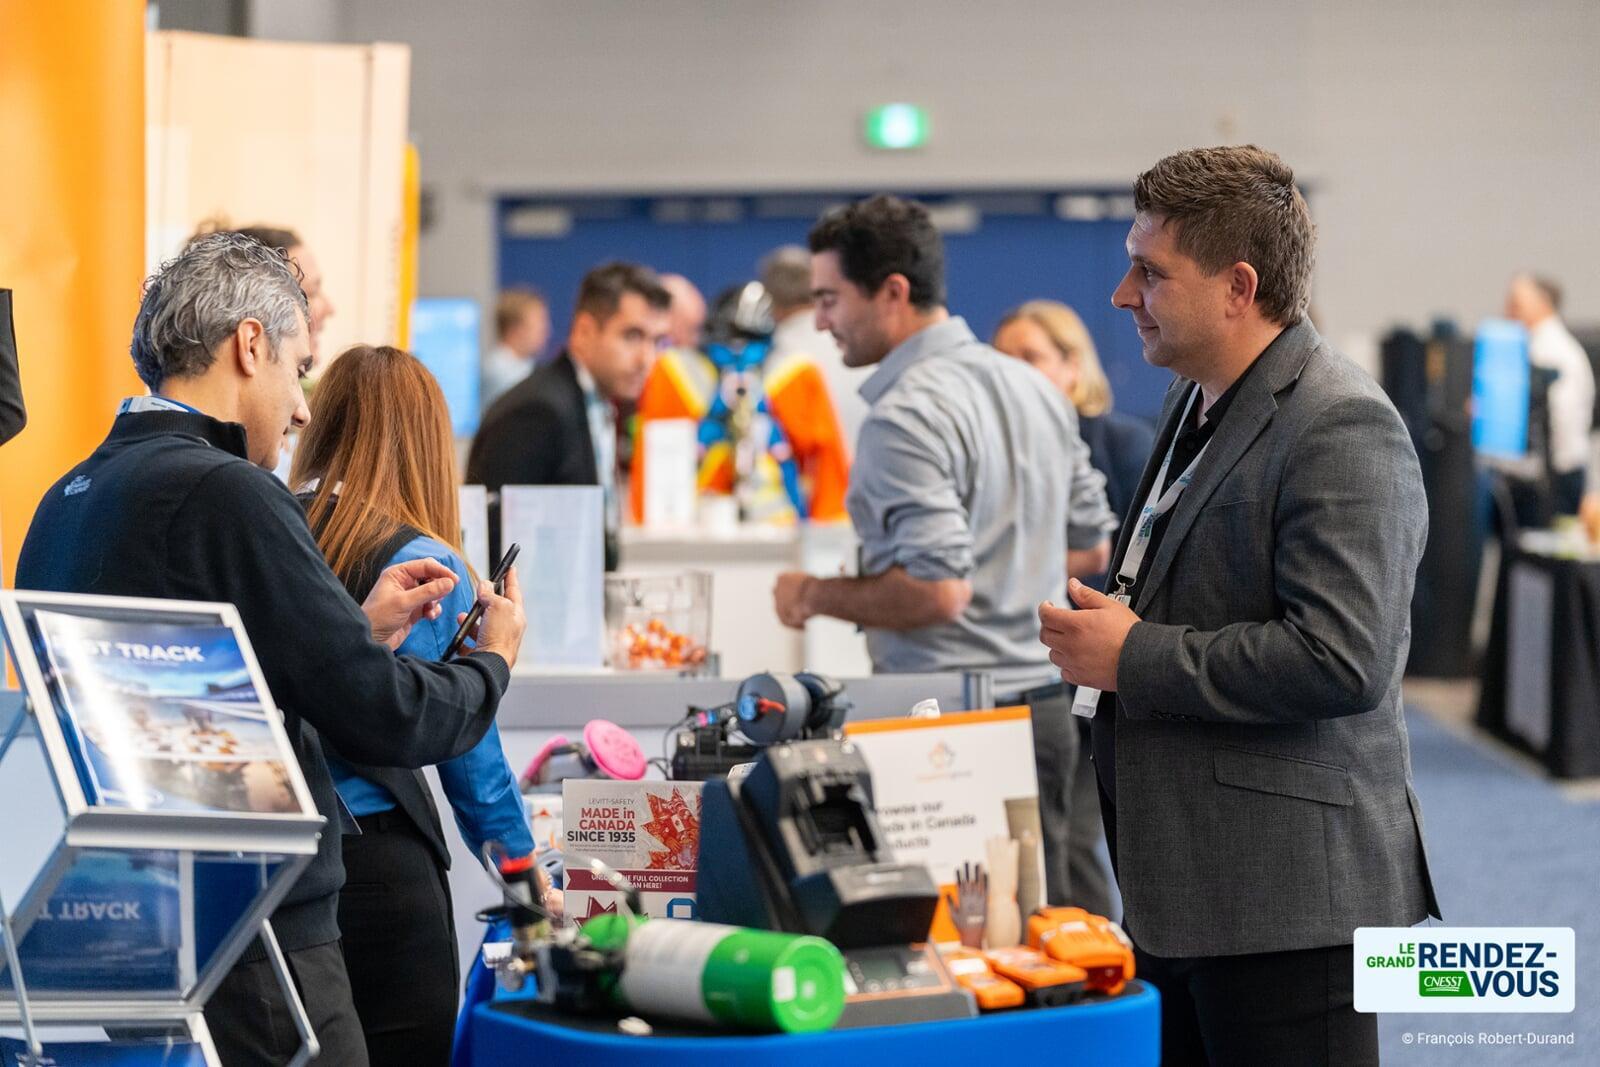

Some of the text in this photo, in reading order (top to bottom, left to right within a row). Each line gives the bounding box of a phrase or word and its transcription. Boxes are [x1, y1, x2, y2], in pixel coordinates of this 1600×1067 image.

[115, 641, 205, 663] TRACK
[581, 807, 635, 819] MADE in
[922, 800, 944, 814] our
[579, 819, 636, 831] CANADA
[925, 813, 977, 829] Canada
[567, 830, 636, 843] SINCE 1935
[633, 874, 647, 882] FULL
[648, 875, 689, 883] COLLECTION
